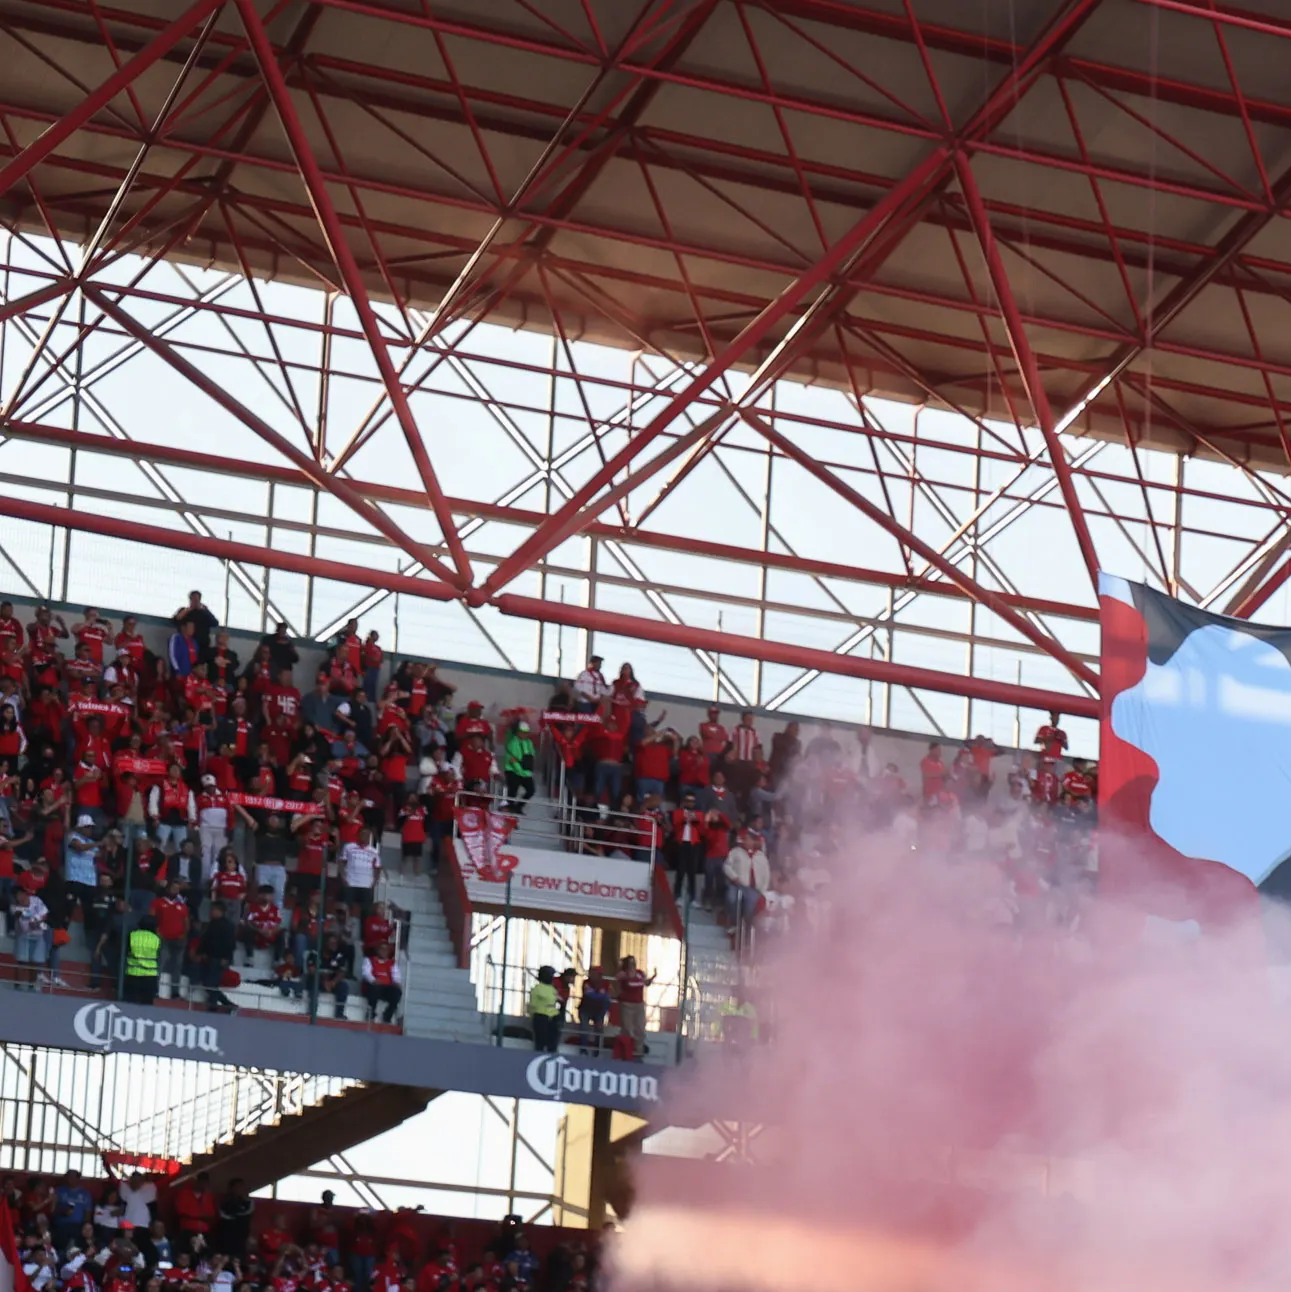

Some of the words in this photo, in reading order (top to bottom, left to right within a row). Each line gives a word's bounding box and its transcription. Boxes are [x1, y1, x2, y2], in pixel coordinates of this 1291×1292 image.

[521, 873, 561, 890] new
[567, 877, 649, 901] balance
[73, 1002, 220, 1053] Corona
[526, 1054, 659, 1101] Corona
